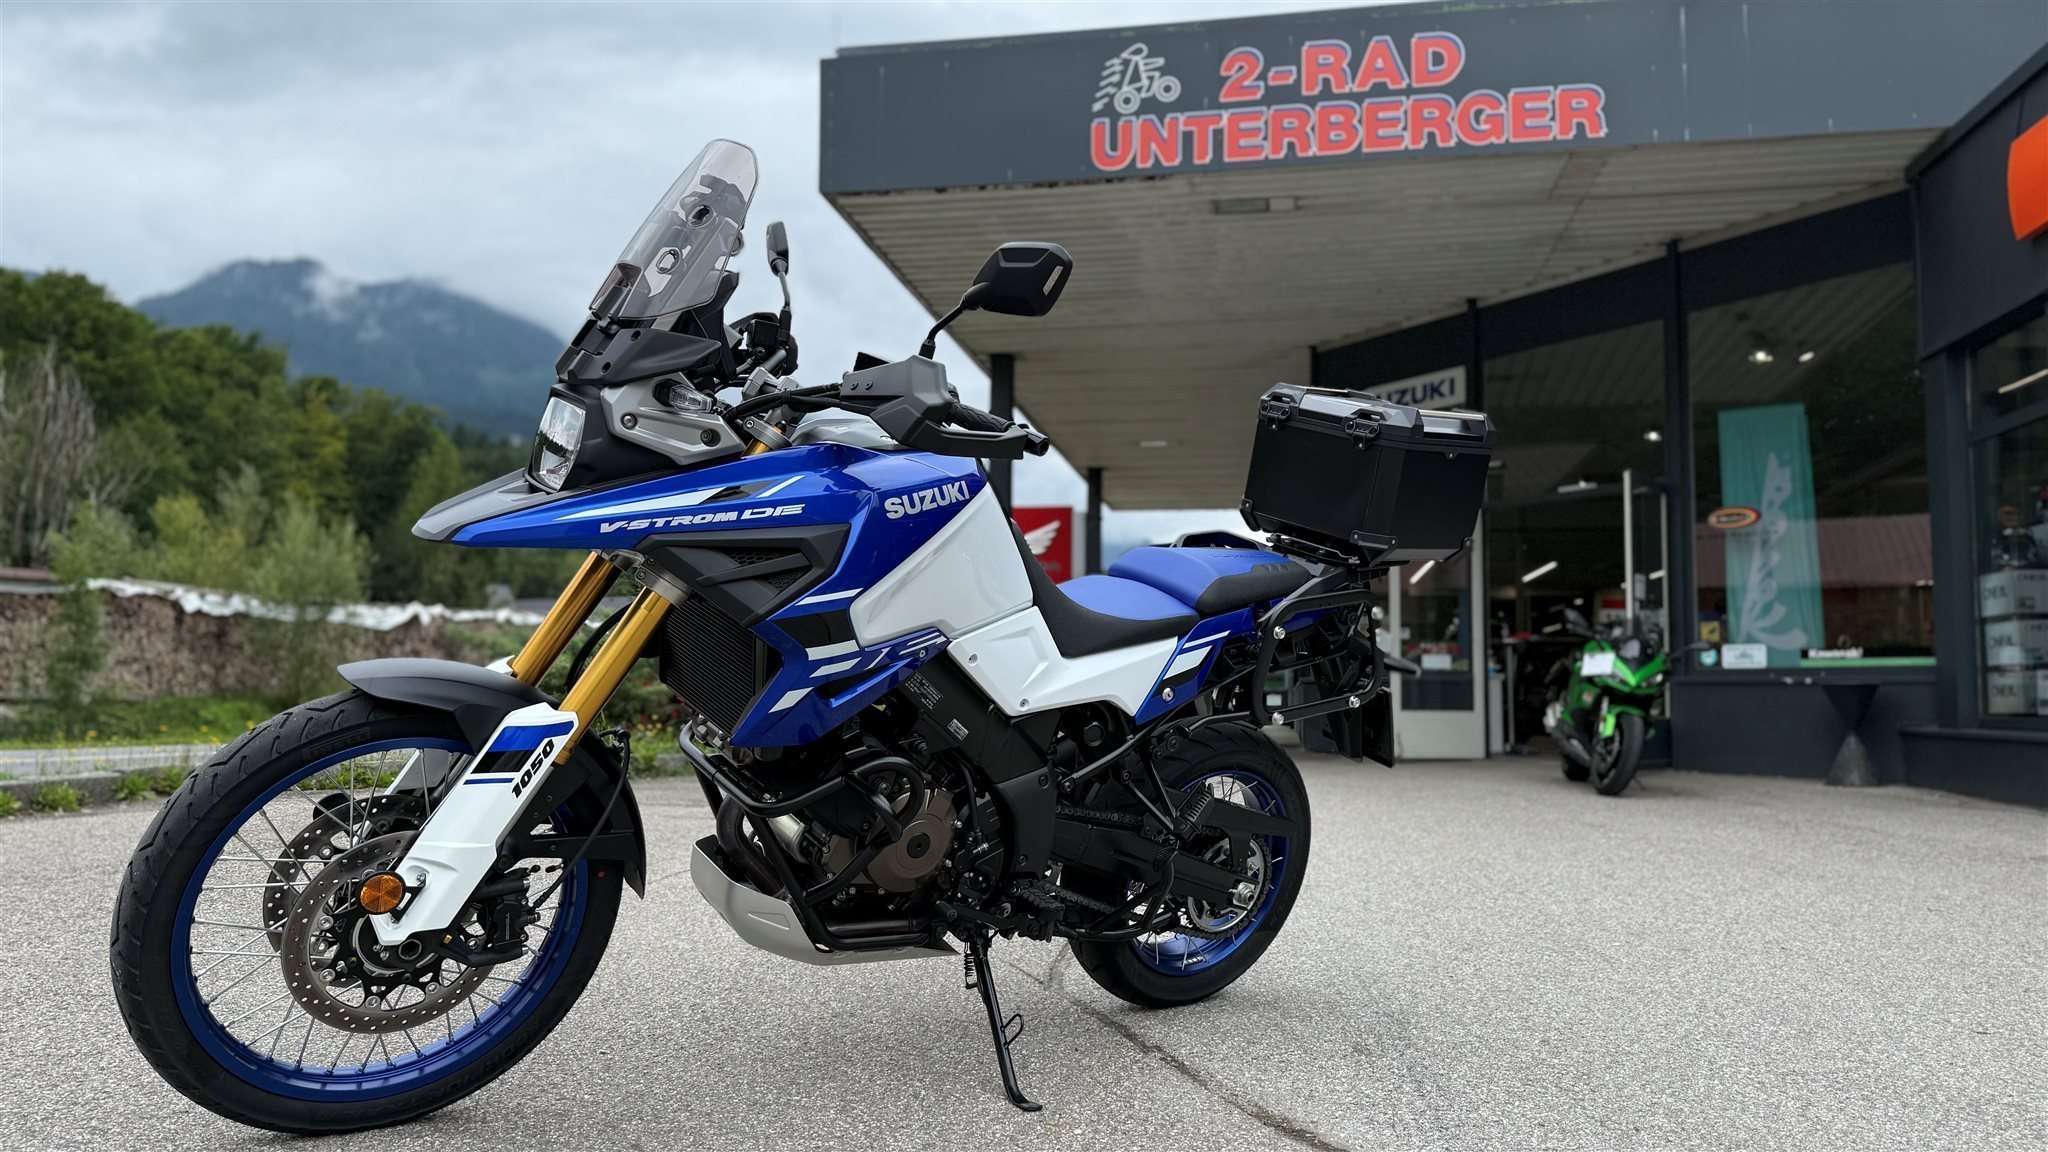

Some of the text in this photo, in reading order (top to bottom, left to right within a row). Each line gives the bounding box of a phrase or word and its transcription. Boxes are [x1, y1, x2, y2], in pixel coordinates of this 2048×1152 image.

[1219, 32, 1465, 102] 2-RAD
[1091, 84, 1608, 171] UNTERBERGER
[600, 503, 804, 533] V-STROM DE
[884, 481, 969, 519] SUZUKI
[511, 738, 555, 799] 1050
